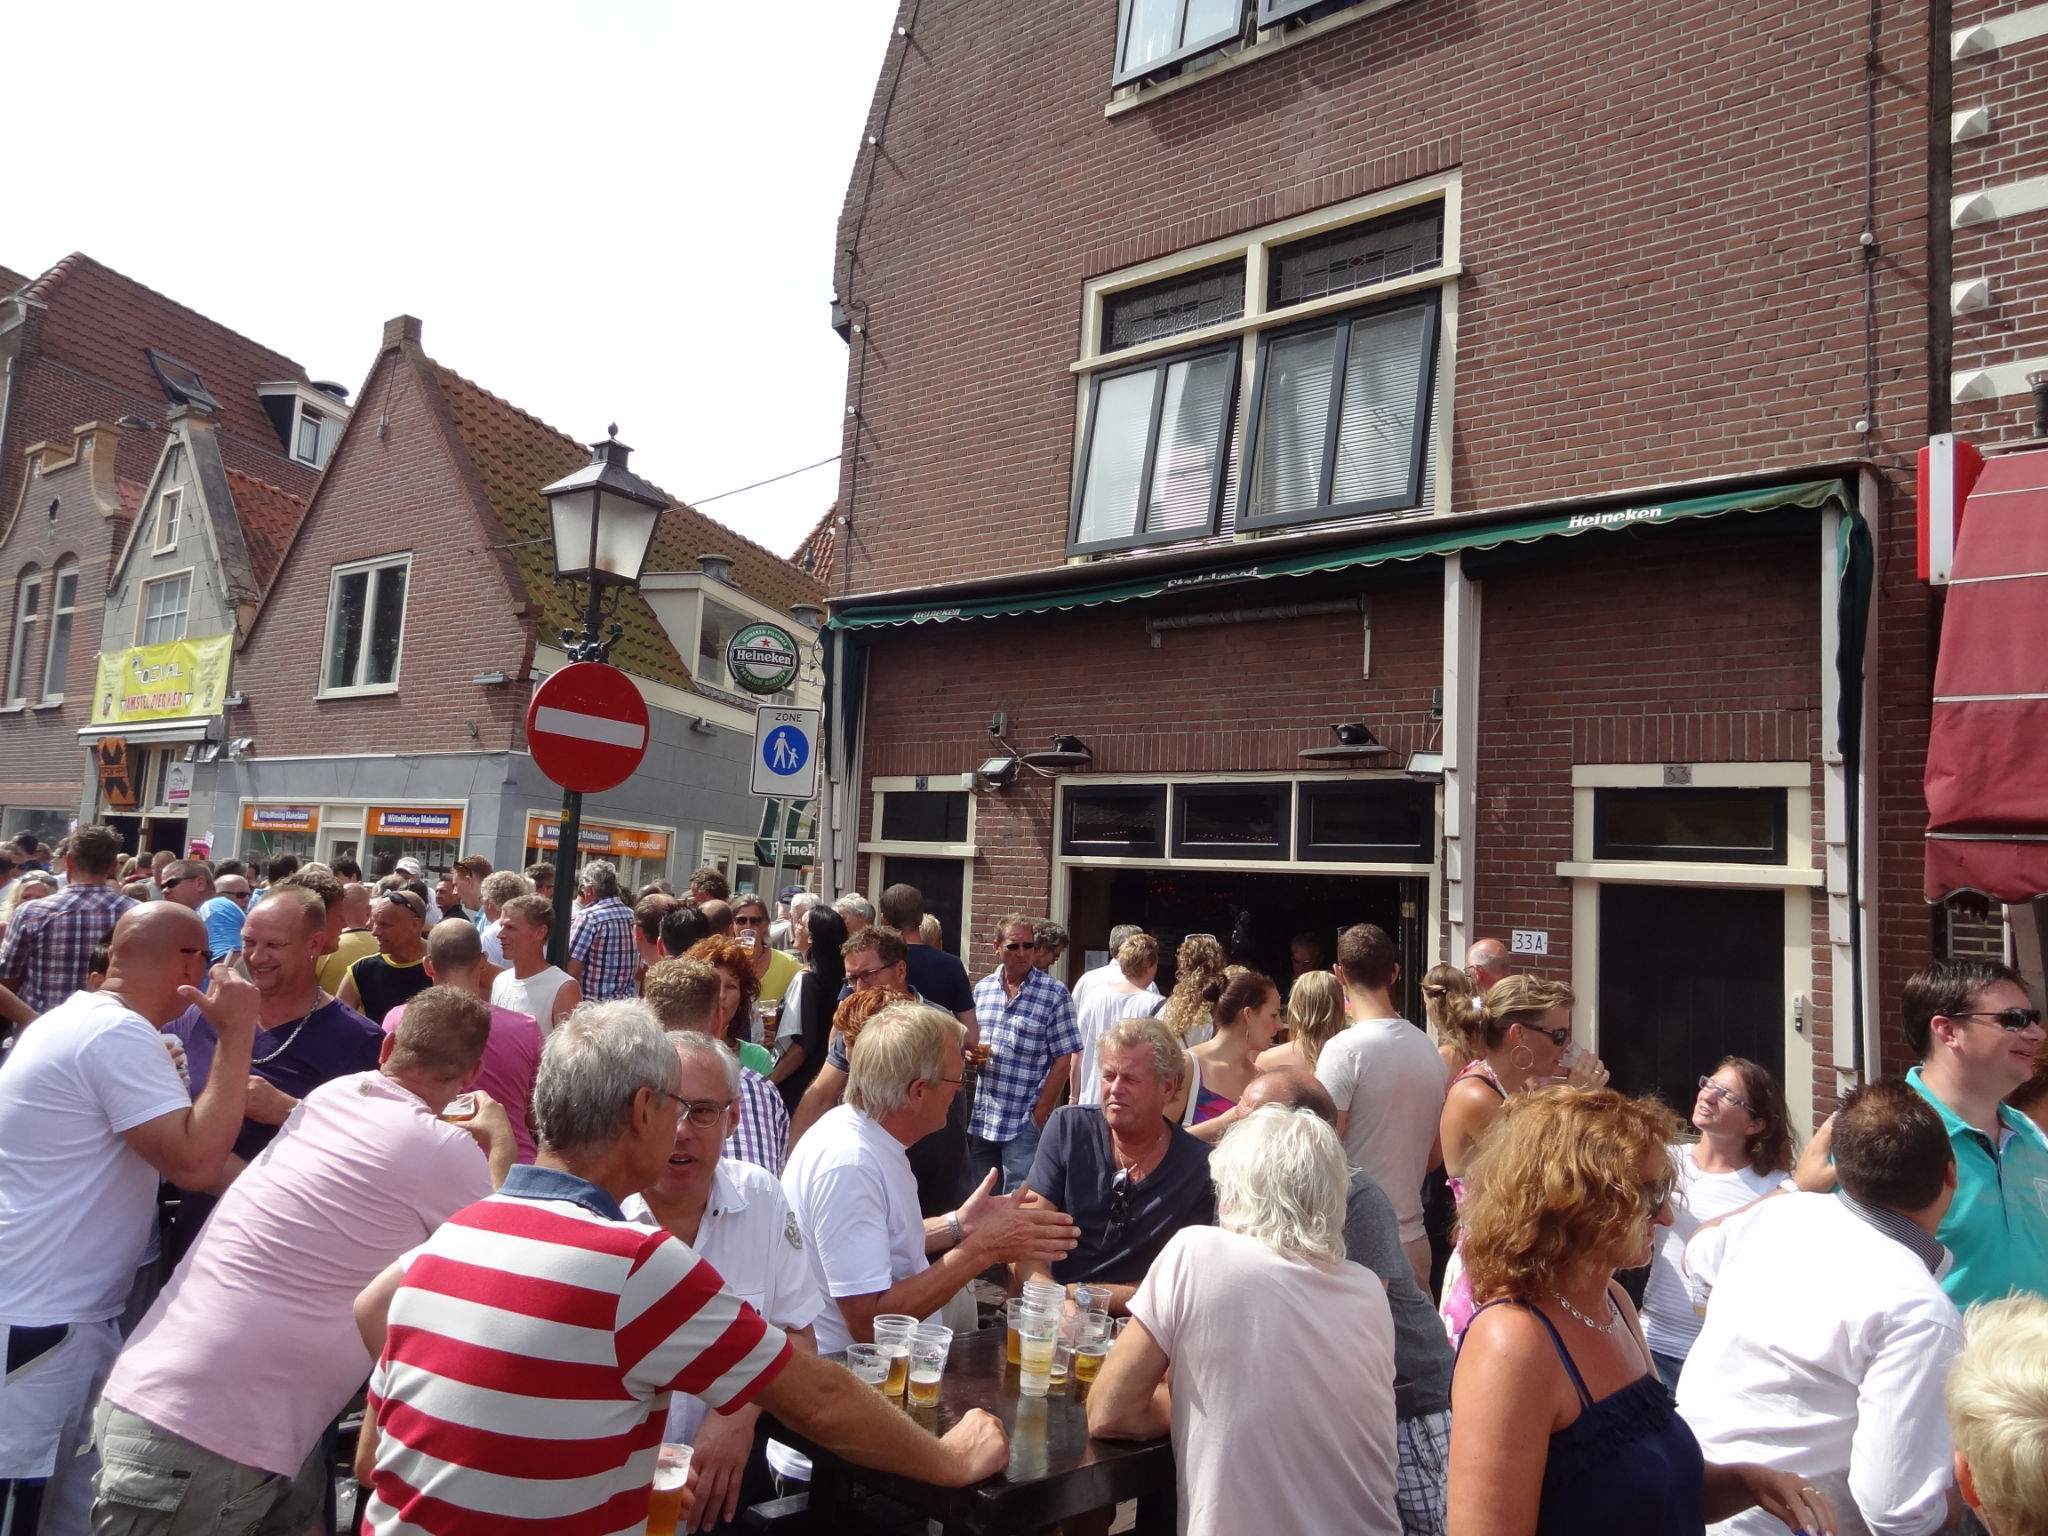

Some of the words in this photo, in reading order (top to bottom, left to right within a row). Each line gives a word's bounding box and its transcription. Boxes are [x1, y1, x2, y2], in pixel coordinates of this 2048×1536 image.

[1568, 508, 1662, 528] Heineken
[736, 649, 791, 665] Heineken
[775, 712, 803, 723] ZONE
[1666, 766, 1690, 785] 33
[1515, 933, 1543, 951] 33A
